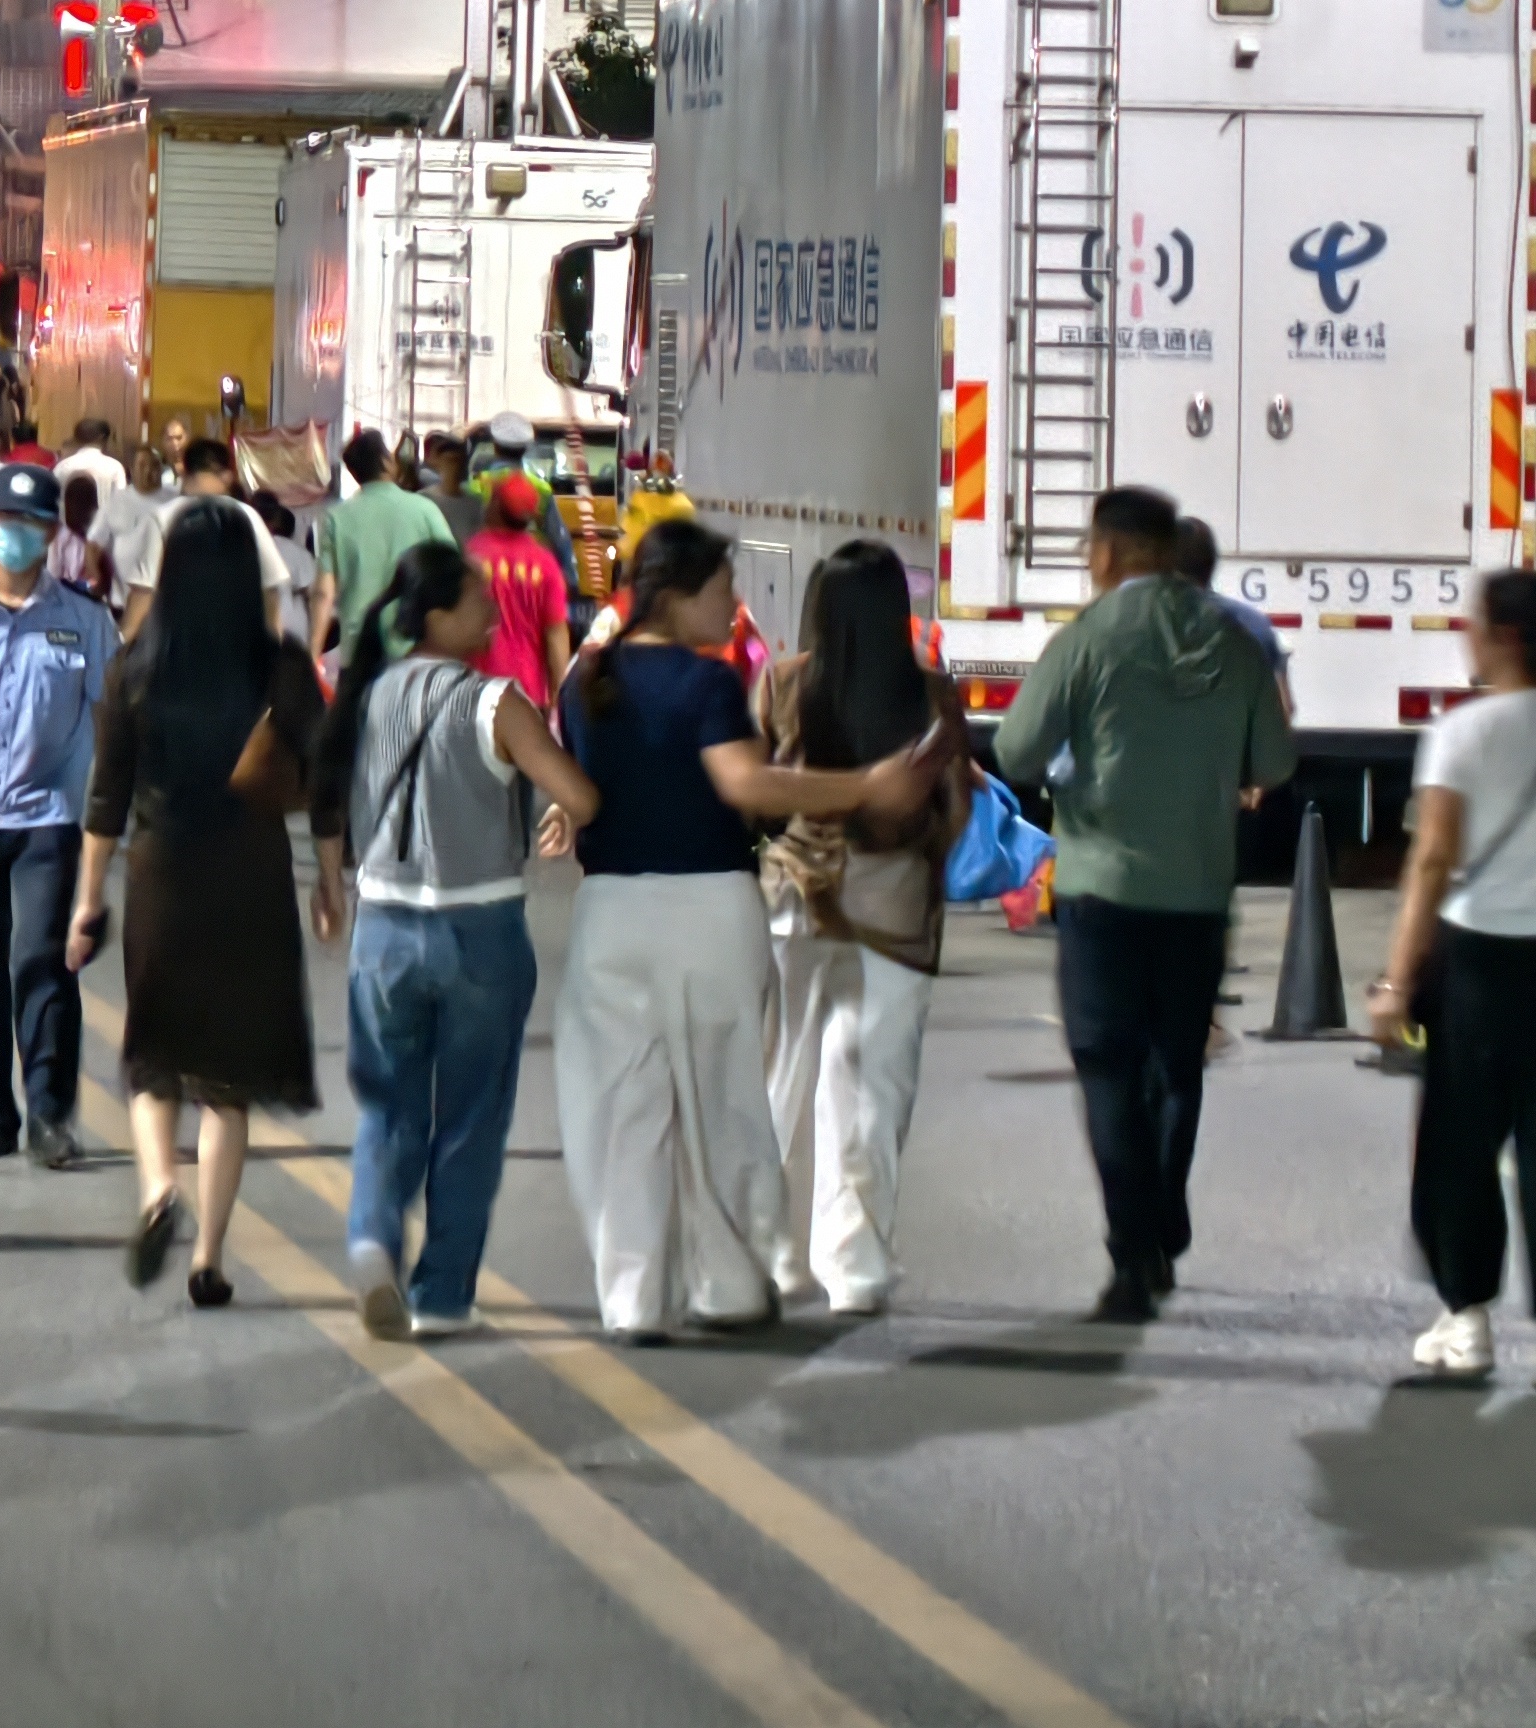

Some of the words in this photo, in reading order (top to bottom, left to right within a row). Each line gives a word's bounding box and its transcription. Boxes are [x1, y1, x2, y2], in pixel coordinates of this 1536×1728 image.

[754, 233, 879, 332] 国家应急通信
[1287, 319, 1385, 360] 中国电信
